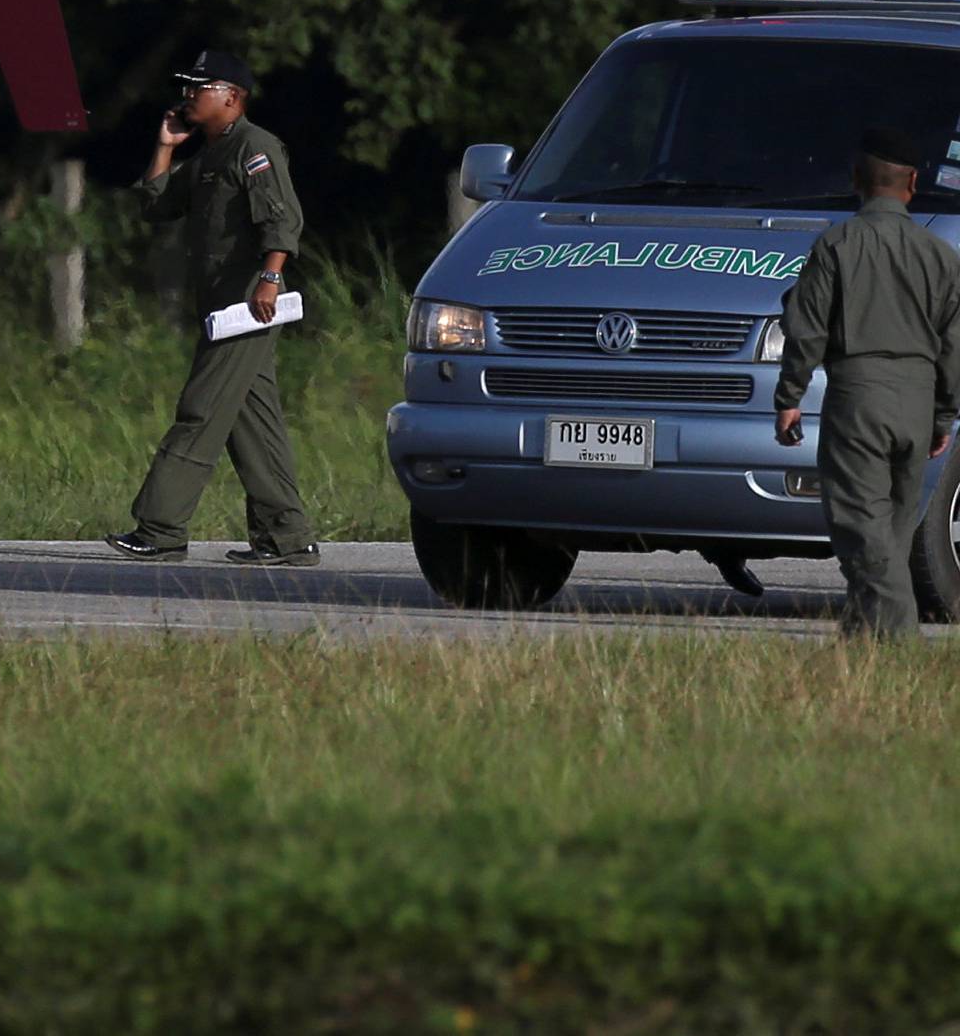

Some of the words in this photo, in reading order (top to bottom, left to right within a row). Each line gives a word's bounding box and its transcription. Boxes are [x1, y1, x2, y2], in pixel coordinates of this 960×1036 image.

[560, 423, 587, 443] กย
[598, 424, 643, 445] 9948
[579, 449, 617, 462] เชียงราย
